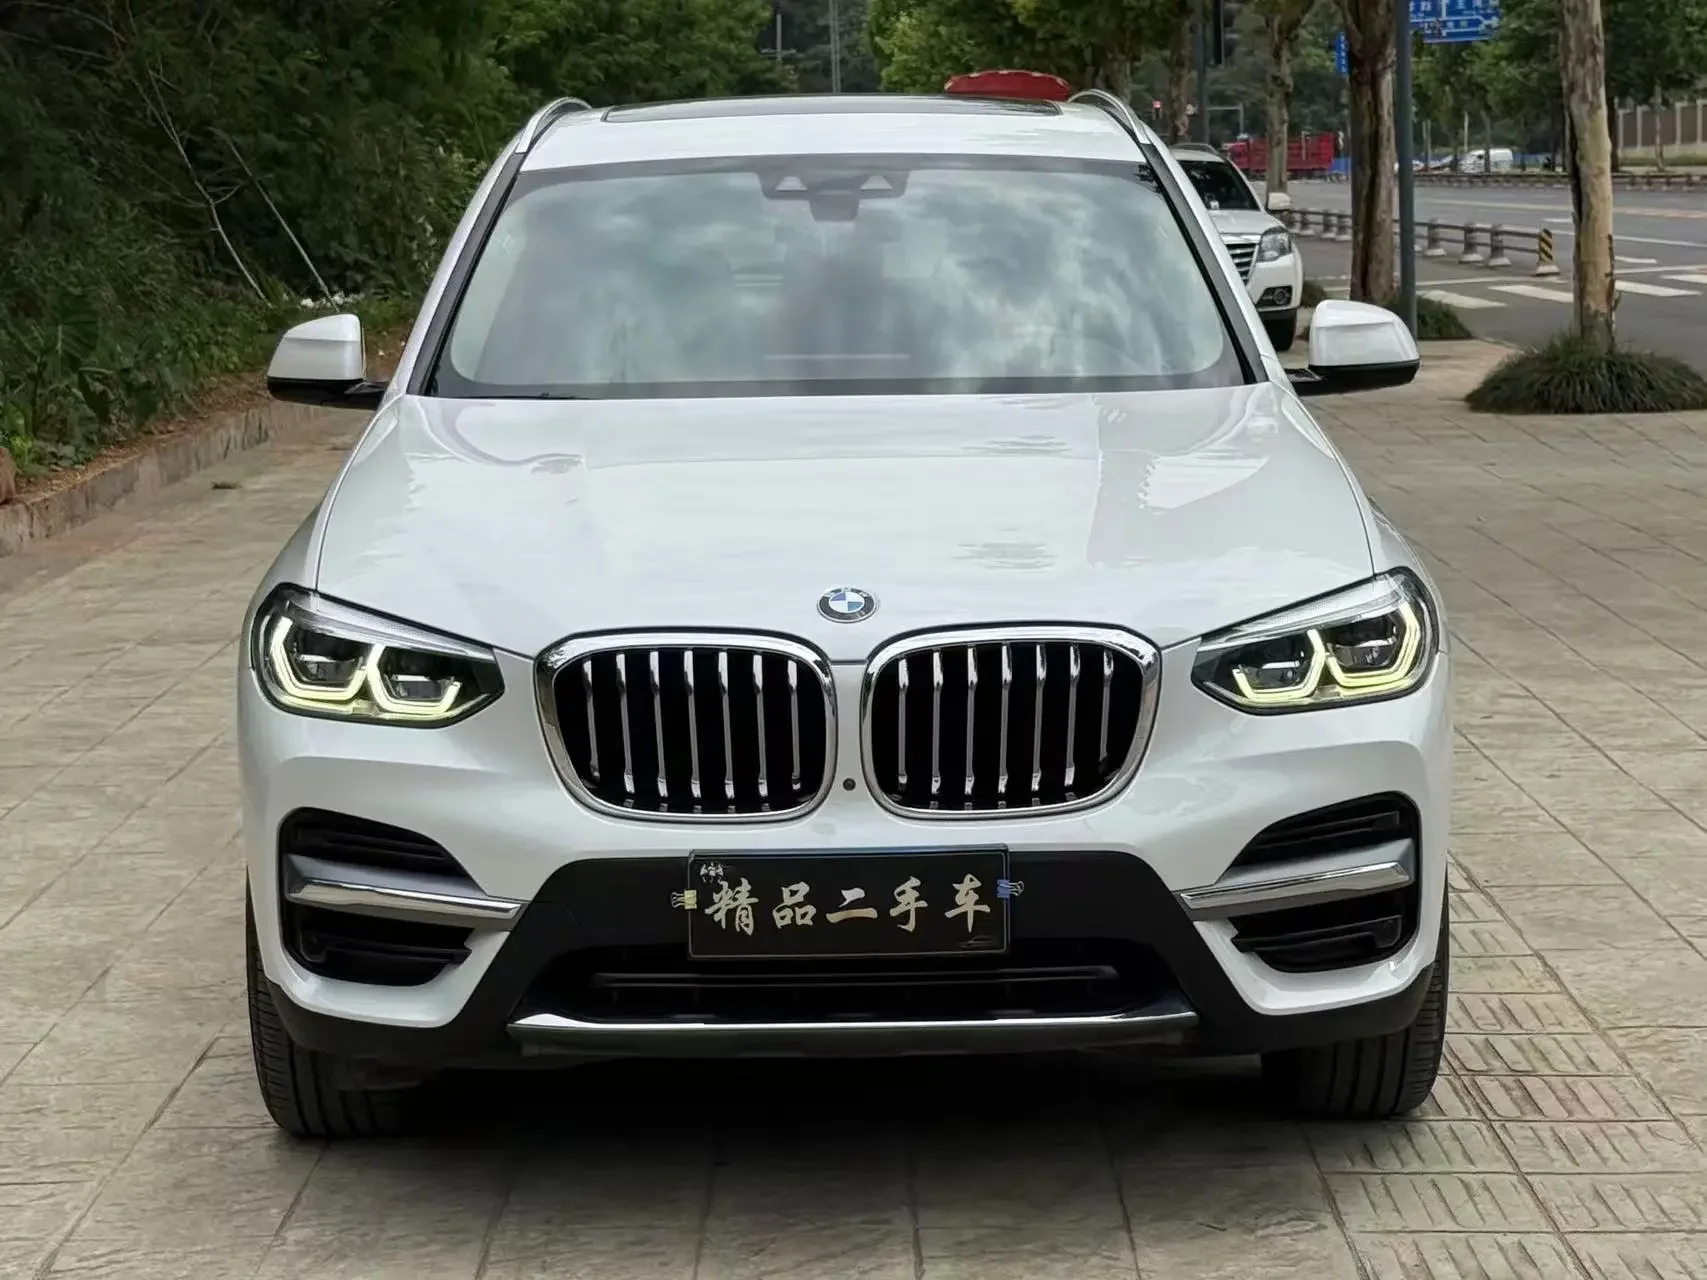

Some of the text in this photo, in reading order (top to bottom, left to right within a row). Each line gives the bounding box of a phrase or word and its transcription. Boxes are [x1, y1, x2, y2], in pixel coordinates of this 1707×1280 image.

[704, 874, 991, 936] 精品二手车
